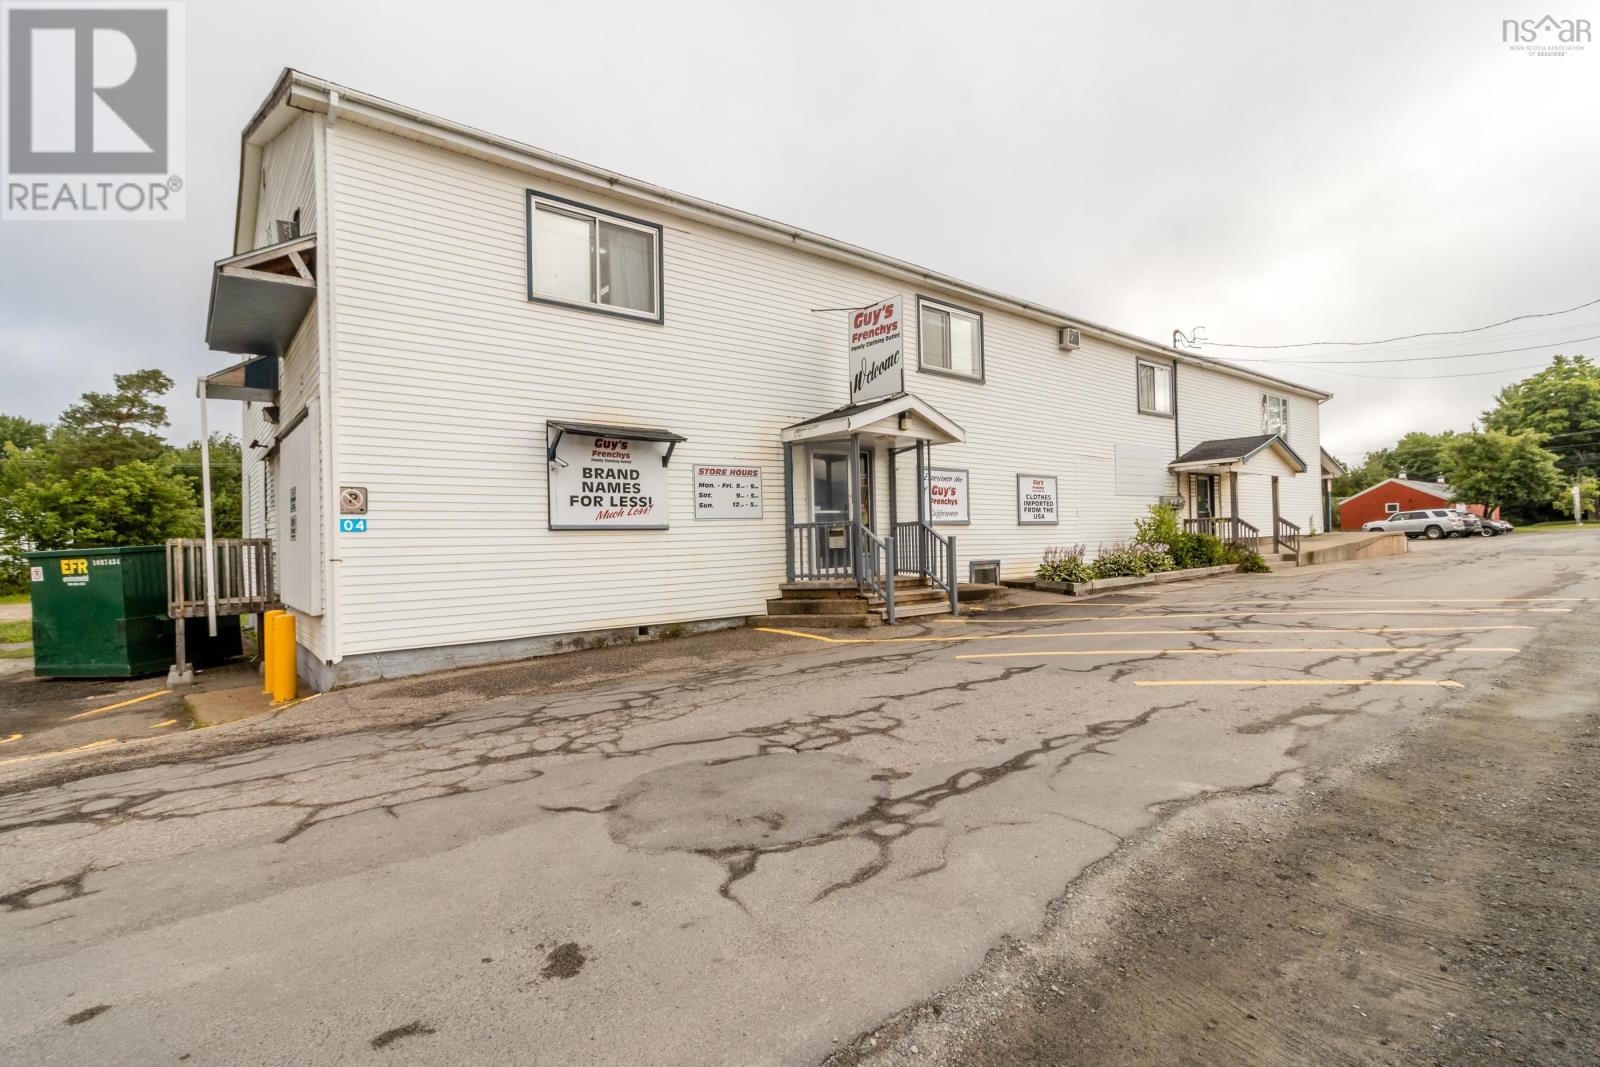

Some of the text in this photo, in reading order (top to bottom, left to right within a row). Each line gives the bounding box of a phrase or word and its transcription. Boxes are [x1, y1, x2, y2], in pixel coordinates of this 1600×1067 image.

[853, 303, 895, 329] Guy's
[851, 321, 898, 343] Frenchys
[853, 350, 900, 394] Welcome
[594, 438, 628, 450] Guy's
[592, 450, 630, 459] Frenchys
[582, 467, 640, 480] BRAND
[582, 482, 641, 494] NAMES
[932, 485, 956, 497] Guy's
[569, 495, 652, 508] FOR LESS!
[595, 504, 654, 520] Much Less!
[61, 559, 88, 575] EFR
